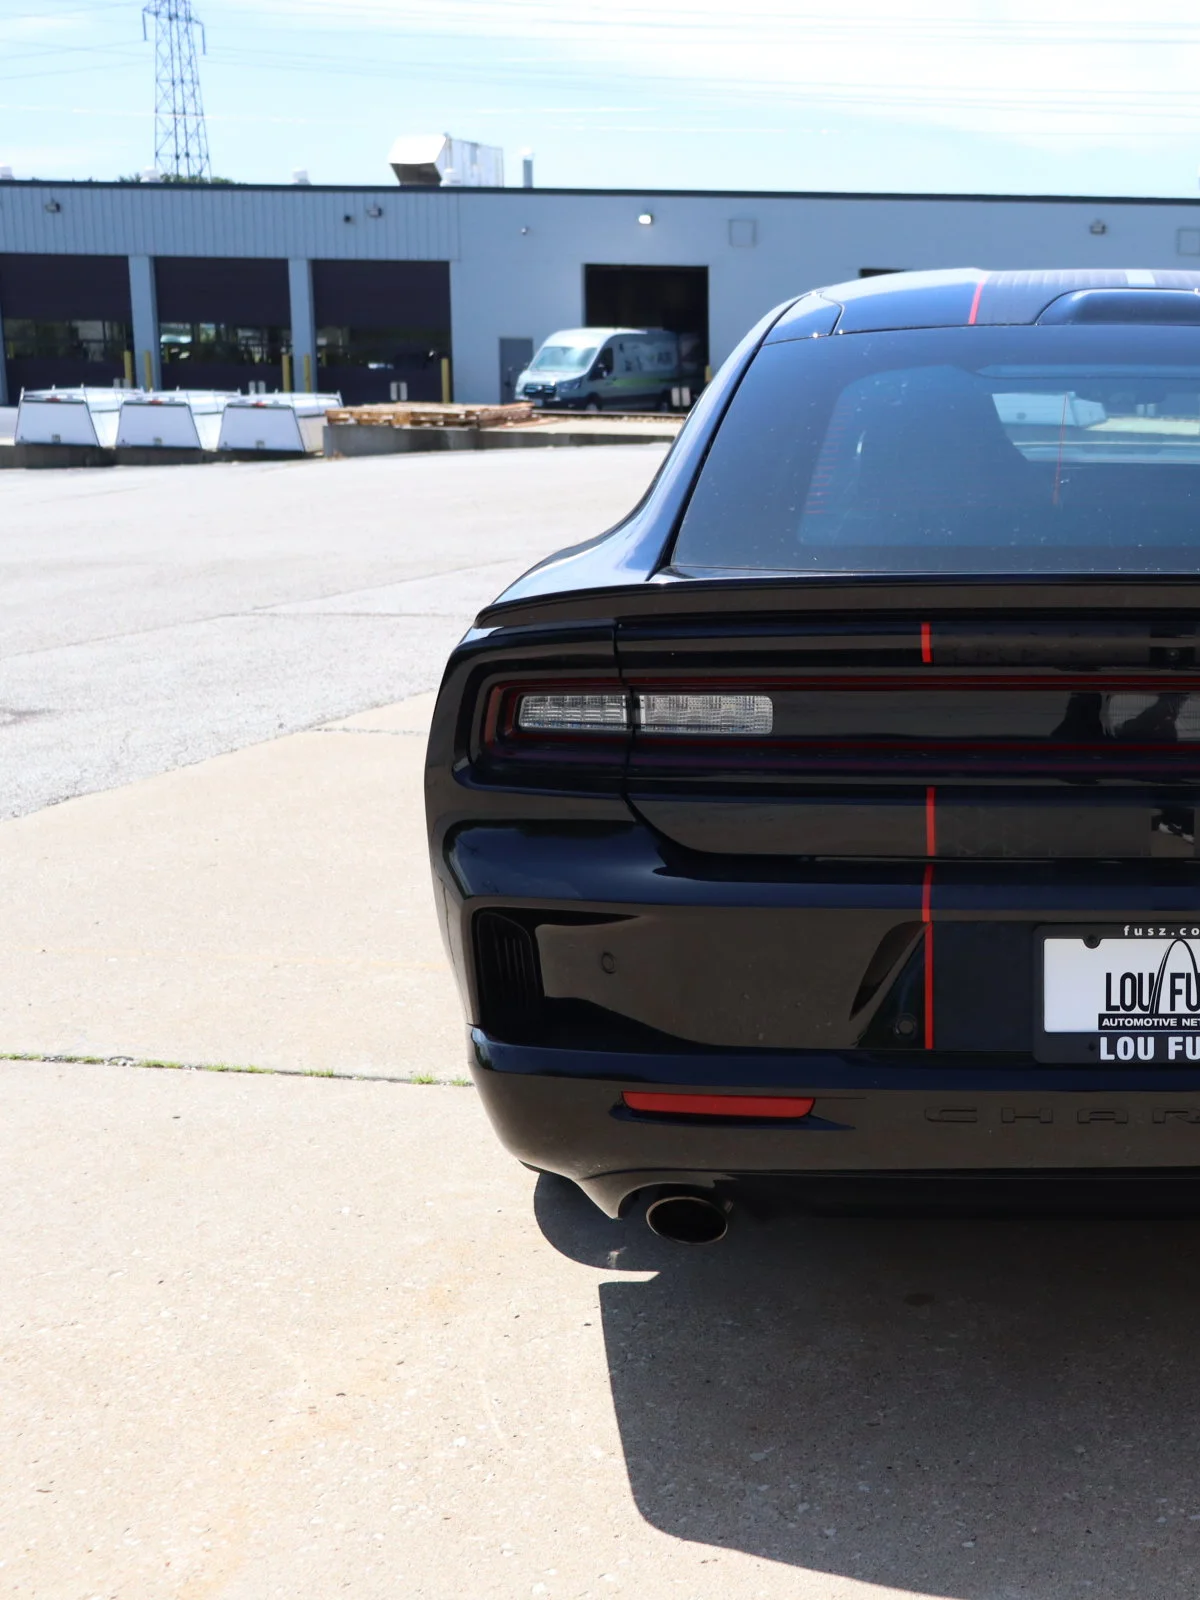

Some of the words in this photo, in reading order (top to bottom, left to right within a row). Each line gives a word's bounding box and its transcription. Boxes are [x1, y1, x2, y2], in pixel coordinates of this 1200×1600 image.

[1105, 972, 1155, 1012] LOU
[1101, 1017, 1178, 1027] AUTOMOTIVE
[1099, 1036, 1155, 1061] LOU
